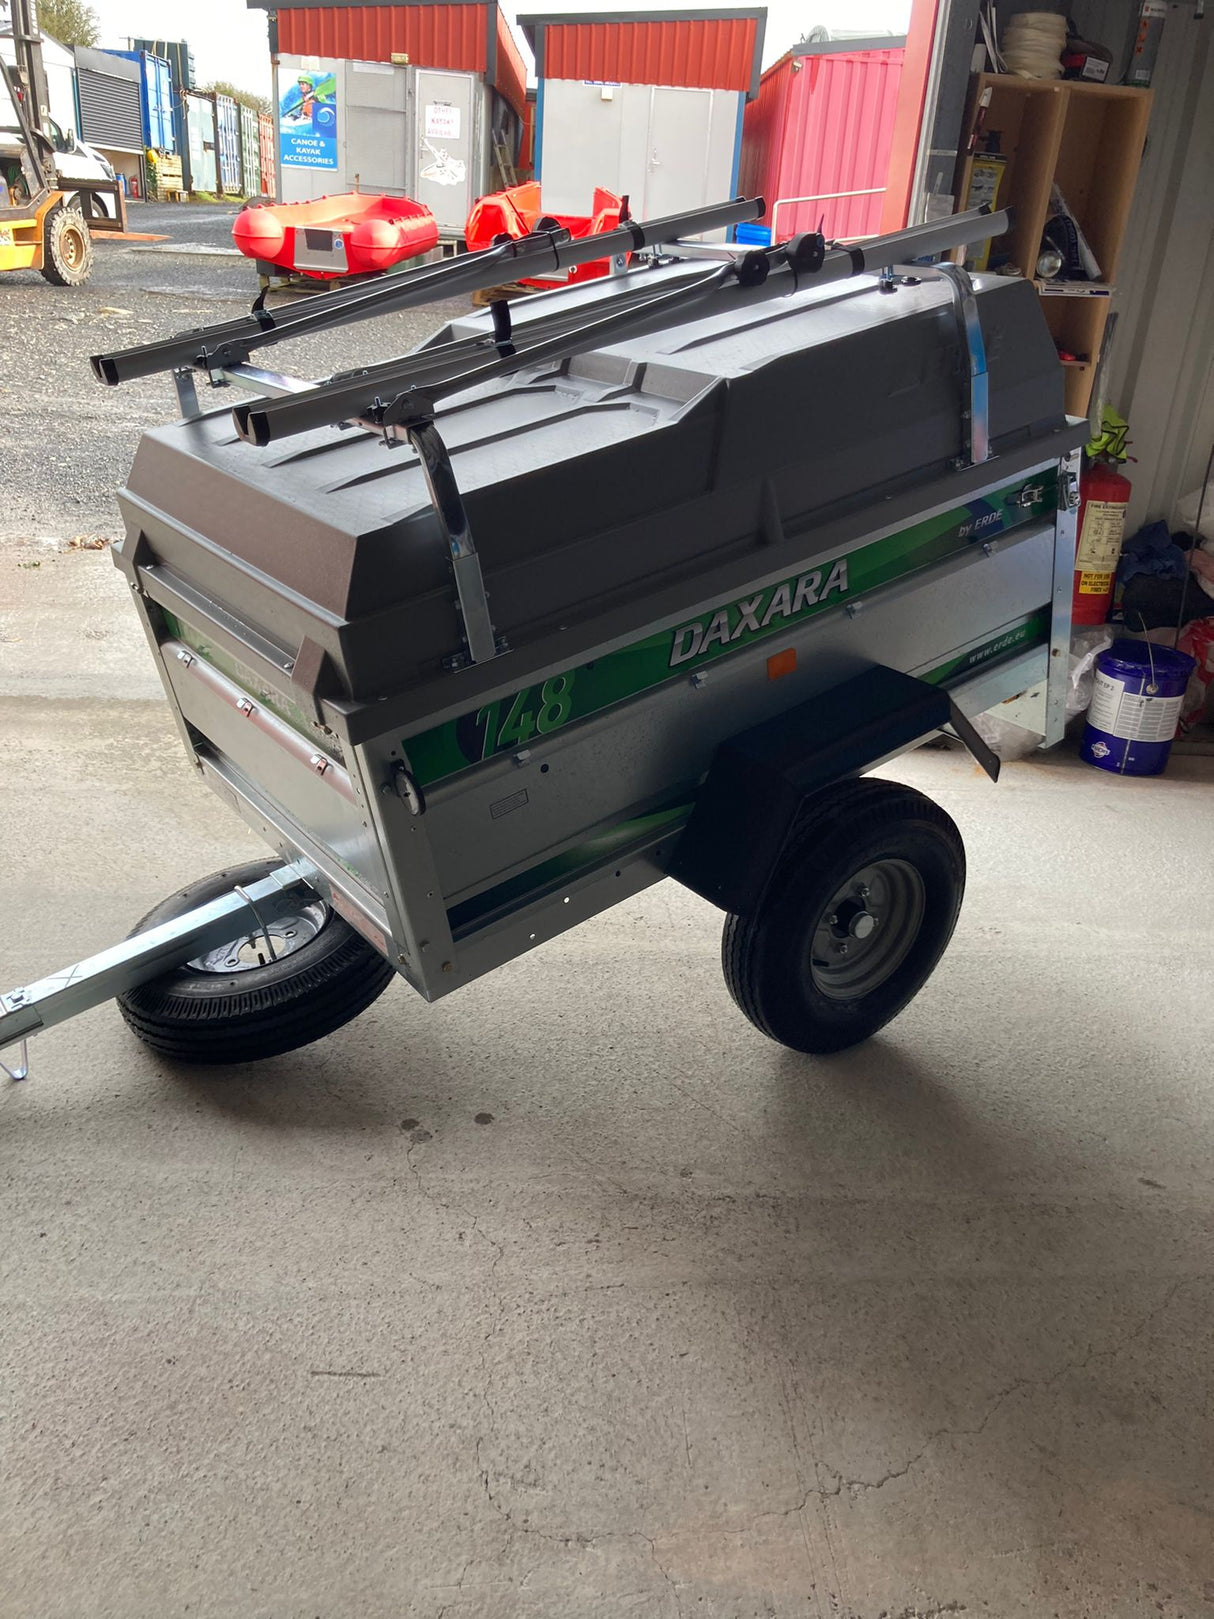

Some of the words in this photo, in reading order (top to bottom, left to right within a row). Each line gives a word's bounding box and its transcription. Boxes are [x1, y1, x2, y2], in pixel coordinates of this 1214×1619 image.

[291, 138, 318, 147] CANOE
[296, 147, 321, 155] KAYAK
[283, 154, 334, 165] ACCESSORIES
[959, 524, 972, 537] by
[975, 508, 1003, 530] ERDE
[669, 558, 848, 667] DAXARA
[969, 630, 1026, 663] www.erde.eu
[475, 668, 576, 761] 148
